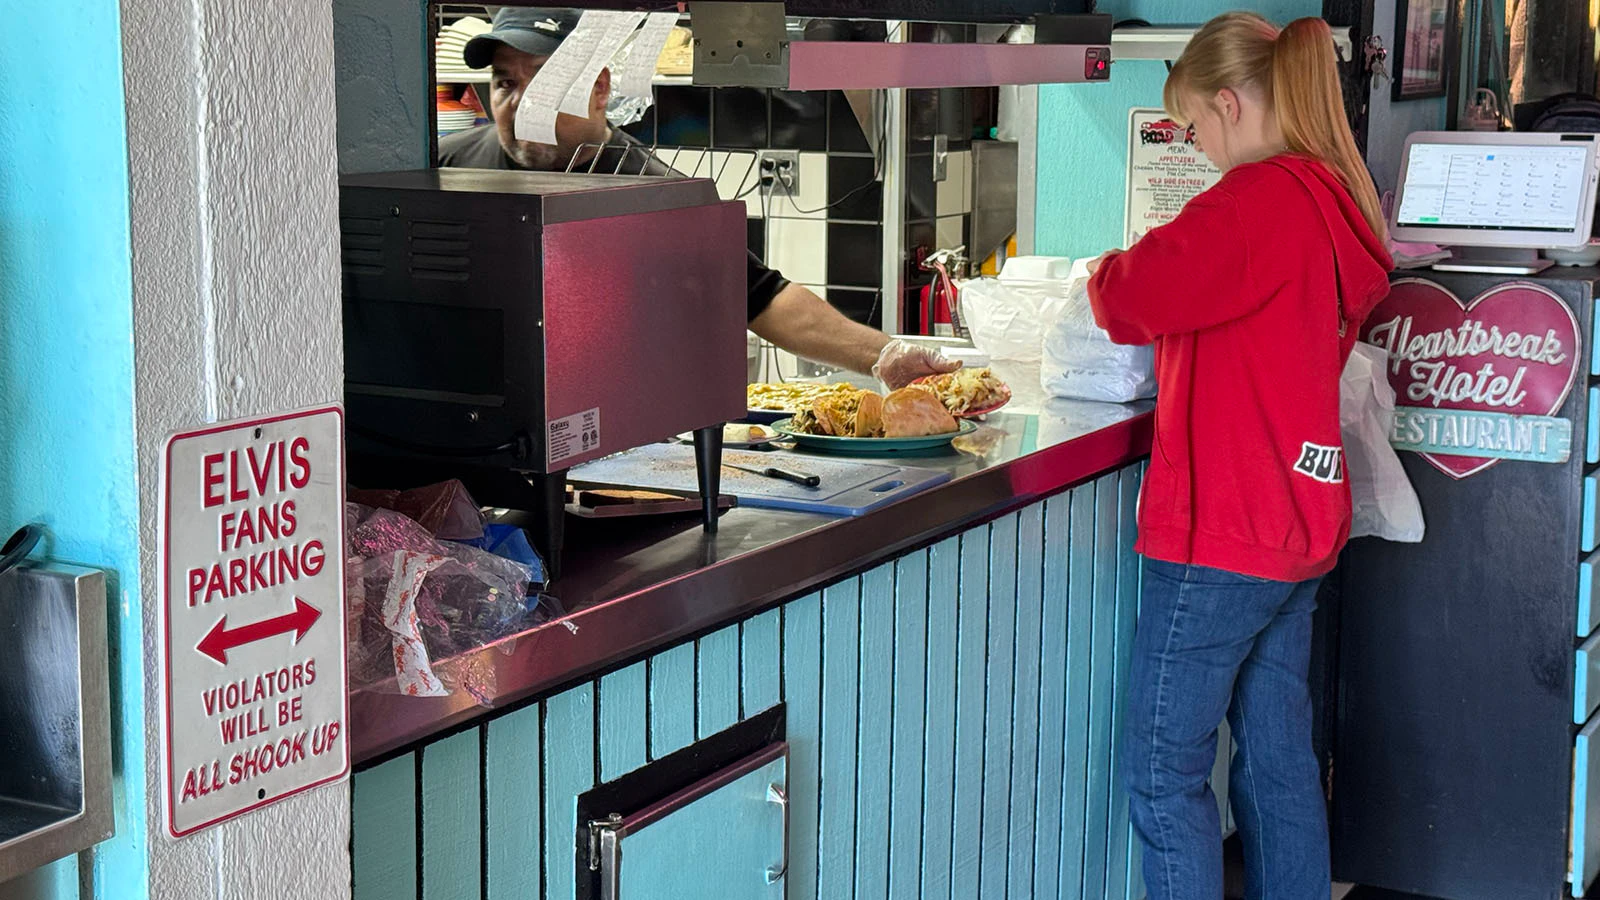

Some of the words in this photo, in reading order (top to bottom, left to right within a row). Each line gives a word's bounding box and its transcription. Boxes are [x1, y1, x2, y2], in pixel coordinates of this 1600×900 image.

[1367, 315, 1566, 375] Heartbreak
[1407, 362, 1527, 407] Hotel
[550, 420, 569, 430] Galaxy
[1390, 411, 1553, 454] ESTAURANT
[203, 436, 311, 509] ELVIS
[220, 500, 297, 552] FANS
[187, 539, 325, 608] PARKING
[203, 660, 315, 716] VIOLATORS
[220, 709, 269, 745] WILL
[278, 696, 302, 725] BE
[182, 758, 224, 803] ALL
[228, 733, 306, 786] SHOOK
[312, 721, 340, 760] UP
